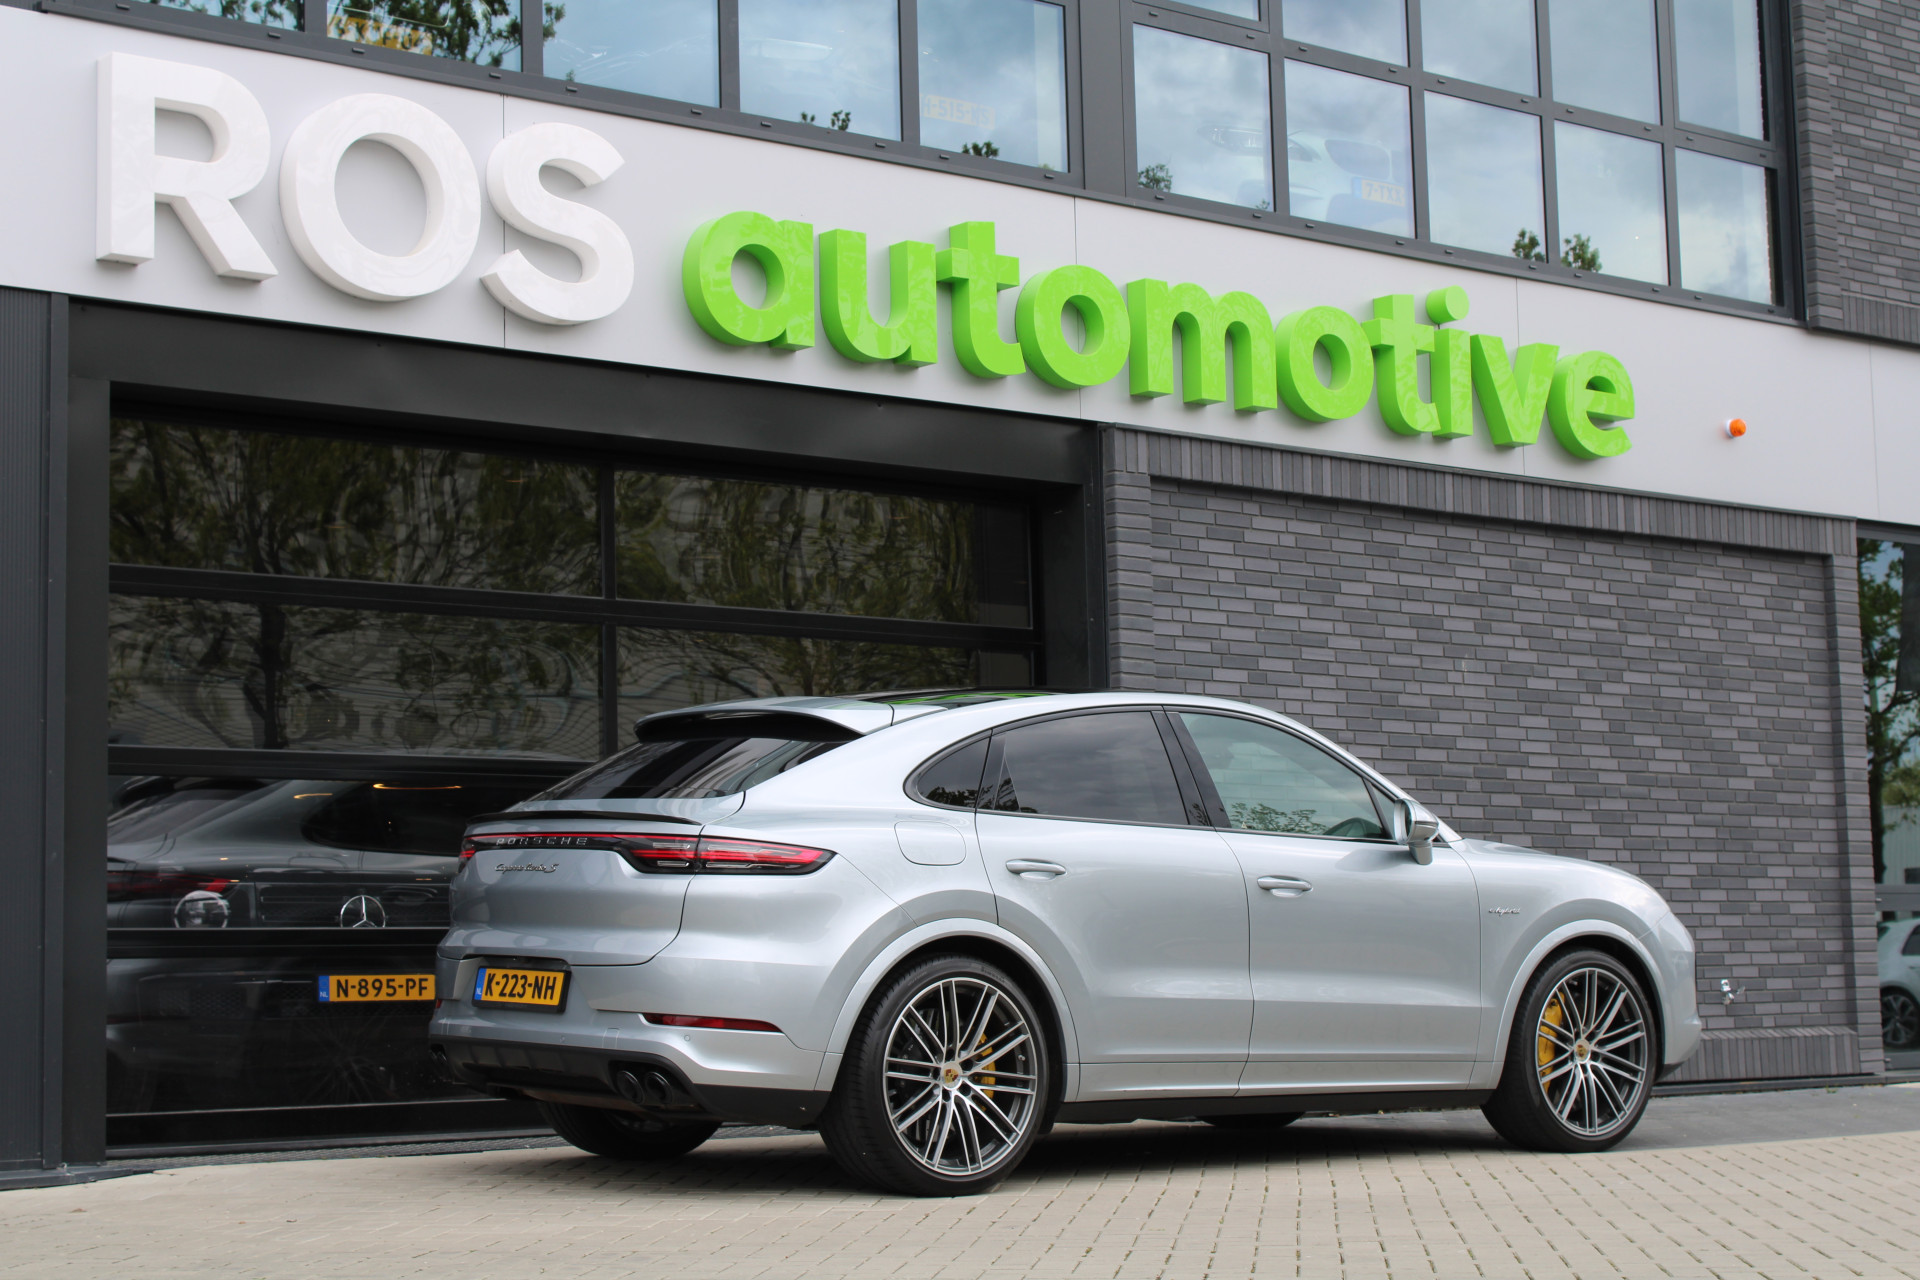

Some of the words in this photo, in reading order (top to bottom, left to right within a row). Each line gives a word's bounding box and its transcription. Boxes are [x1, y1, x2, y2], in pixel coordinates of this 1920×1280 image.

[96, 52, 634, 326] ROS
[682, 211, 1635, 459] automotive
[496, 836, 588, 846] PORSCHE
[336, 978, 429, 998] N-895-PF
[485, 973, 558, 1000] K-223-NH
